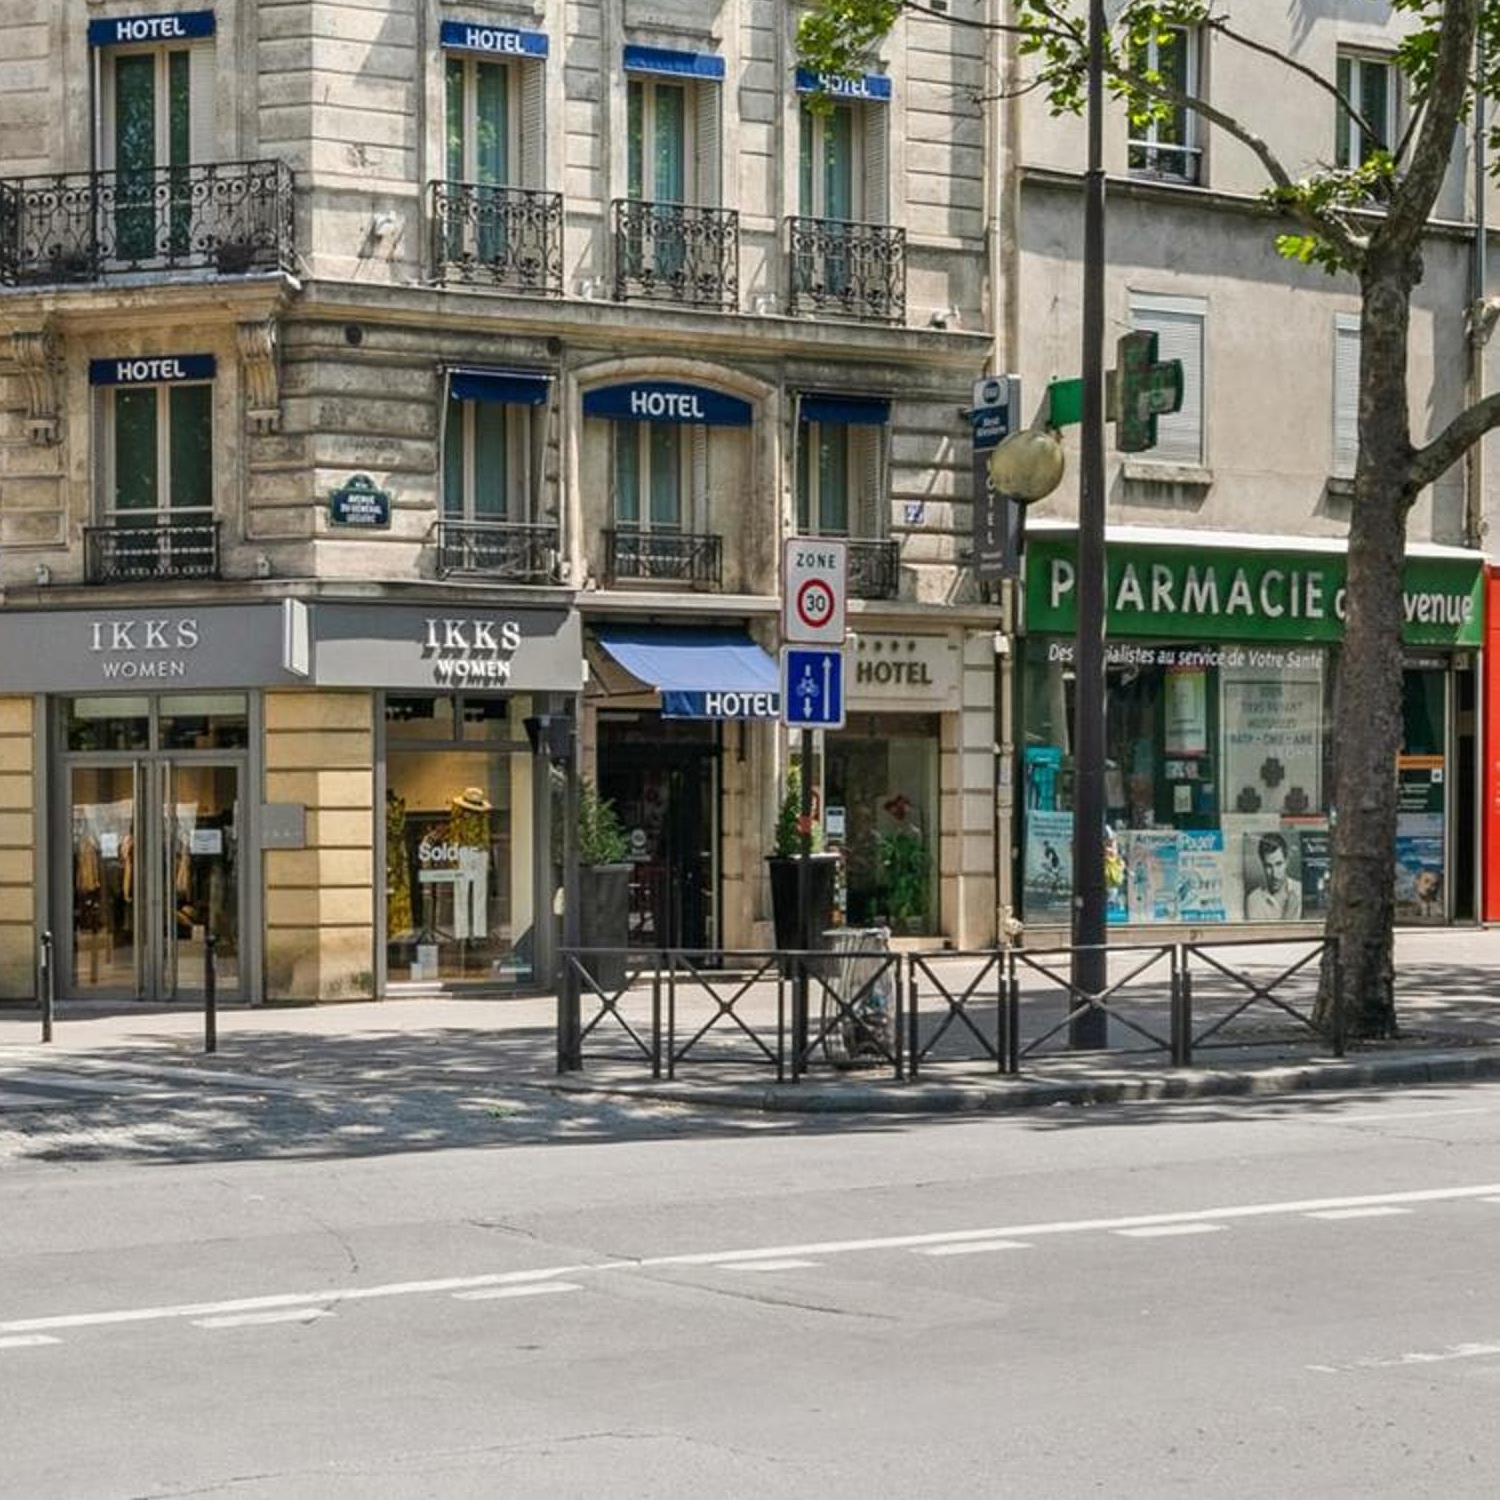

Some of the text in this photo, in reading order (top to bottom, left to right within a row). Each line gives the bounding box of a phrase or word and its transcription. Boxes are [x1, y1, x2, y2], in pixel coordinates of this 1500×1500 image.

[116, 17, 186, 41] HOTEL
[466, 27, 525, 53] HOTEL
[116, 359, 187, 381] HOTEL
[631, 390, 705, 418] HOTEL
[796, 553, 837, 569] ZONE
[1051, 559, 1324, 618] PARMACIE
[806, 593, 826, 612] 30
[1403, 591, 1476, 623] venue
[88, 619, 199, 650] IKKS
[425, 619, 521, 650] IKKS
[1049, 643, 1075, 661] Des
[1105, 645, 1156, 664] ialistes
[1157, 650, 1176, 665] au
[1178, 647, 1224, 667] service
[1225, 646, 1245, 667] de
[1249, 649, 1285, 668] Votre
[103, 661, 185, 677] WOMEN
[437, 659, 511, 677] WOMEN
[857, 661, 933, 684] HOTEL
[705, 692, 781, 716] HOTEL
[418, 841, 480, 862] Sold
